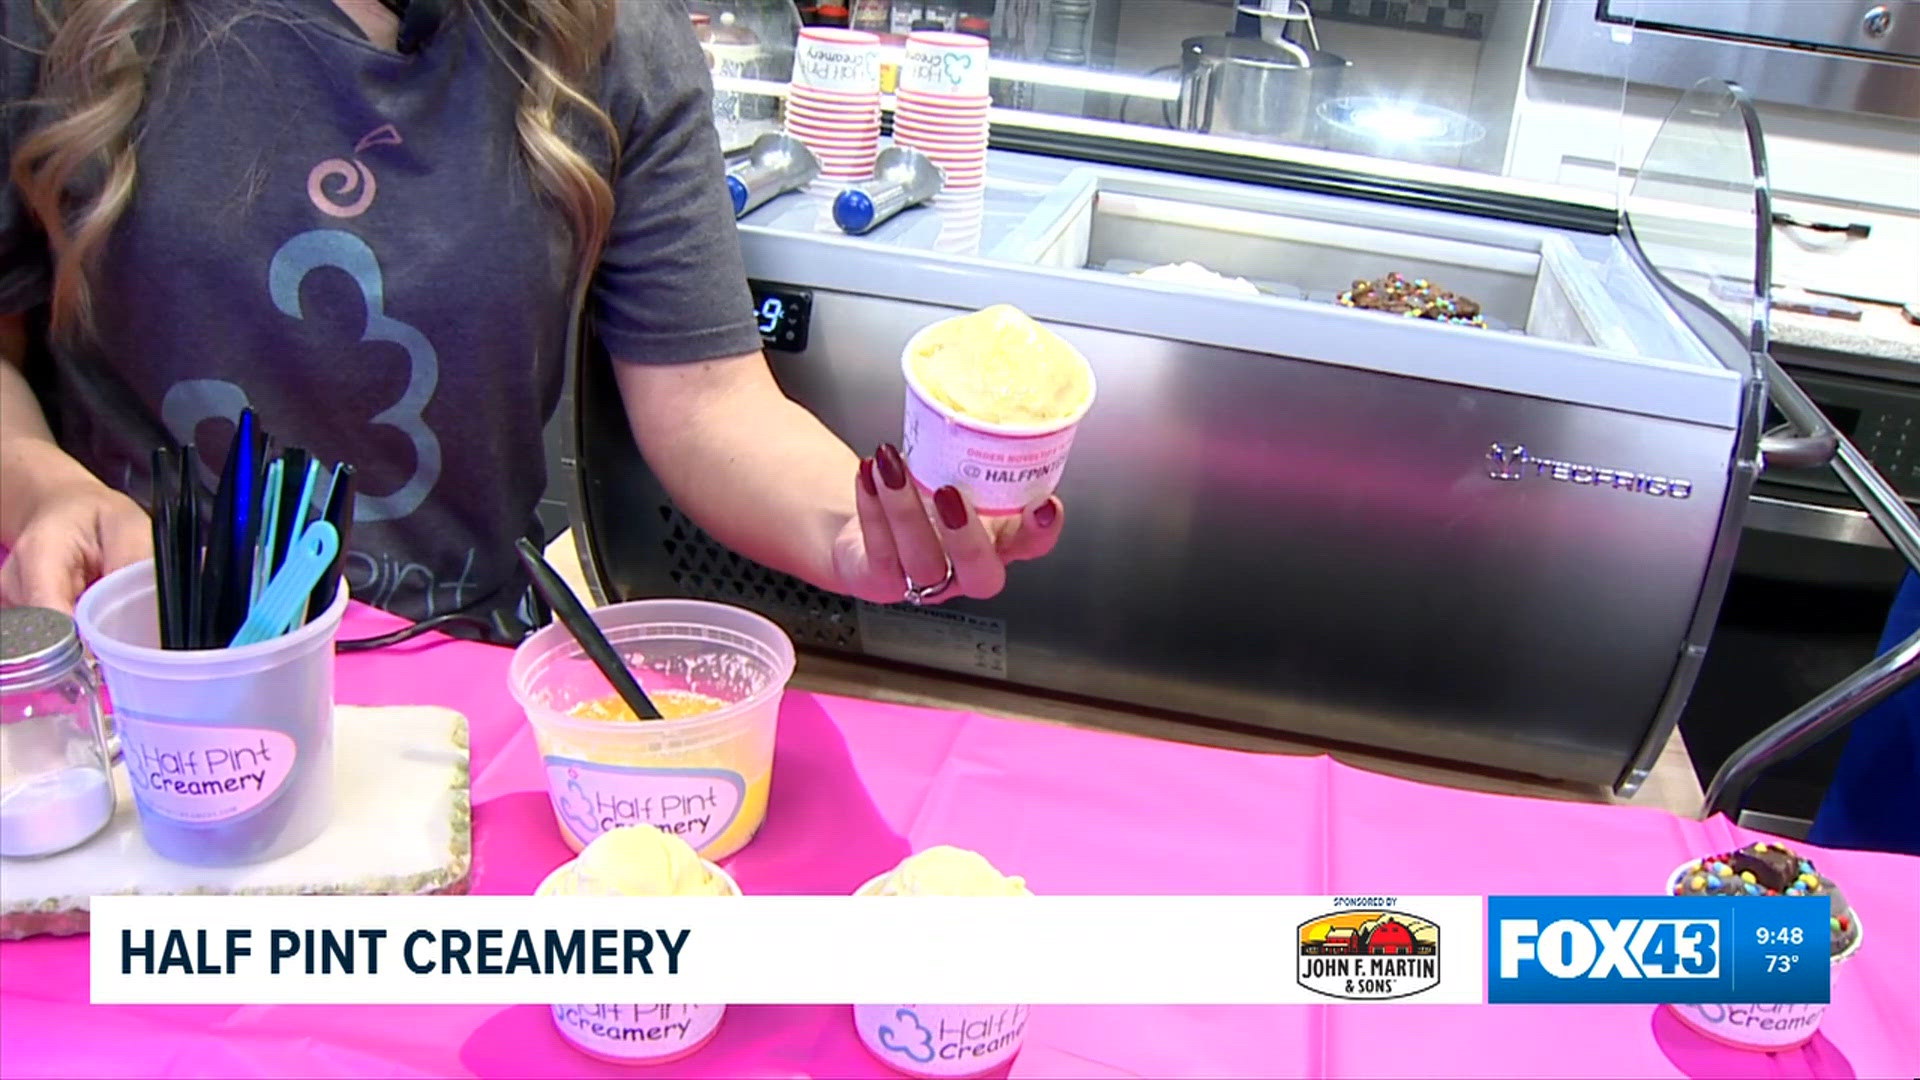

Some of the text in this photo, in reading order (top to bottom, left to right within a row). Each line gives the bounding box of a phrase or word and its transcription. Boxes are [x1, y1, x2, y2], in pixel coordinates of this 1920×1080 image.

[806, 46, 863, 64] Creamery
[1530, 456, 1692, 499] TECFRIGO
[141, 738, 271, 776] Half Pint
[150, 769, 266, 795] Creamery
[596, 786, 717, 821] Half Pint
[600, 814, 711, 836] Cmery
[566, 1008, 692, 1041] Creamery
